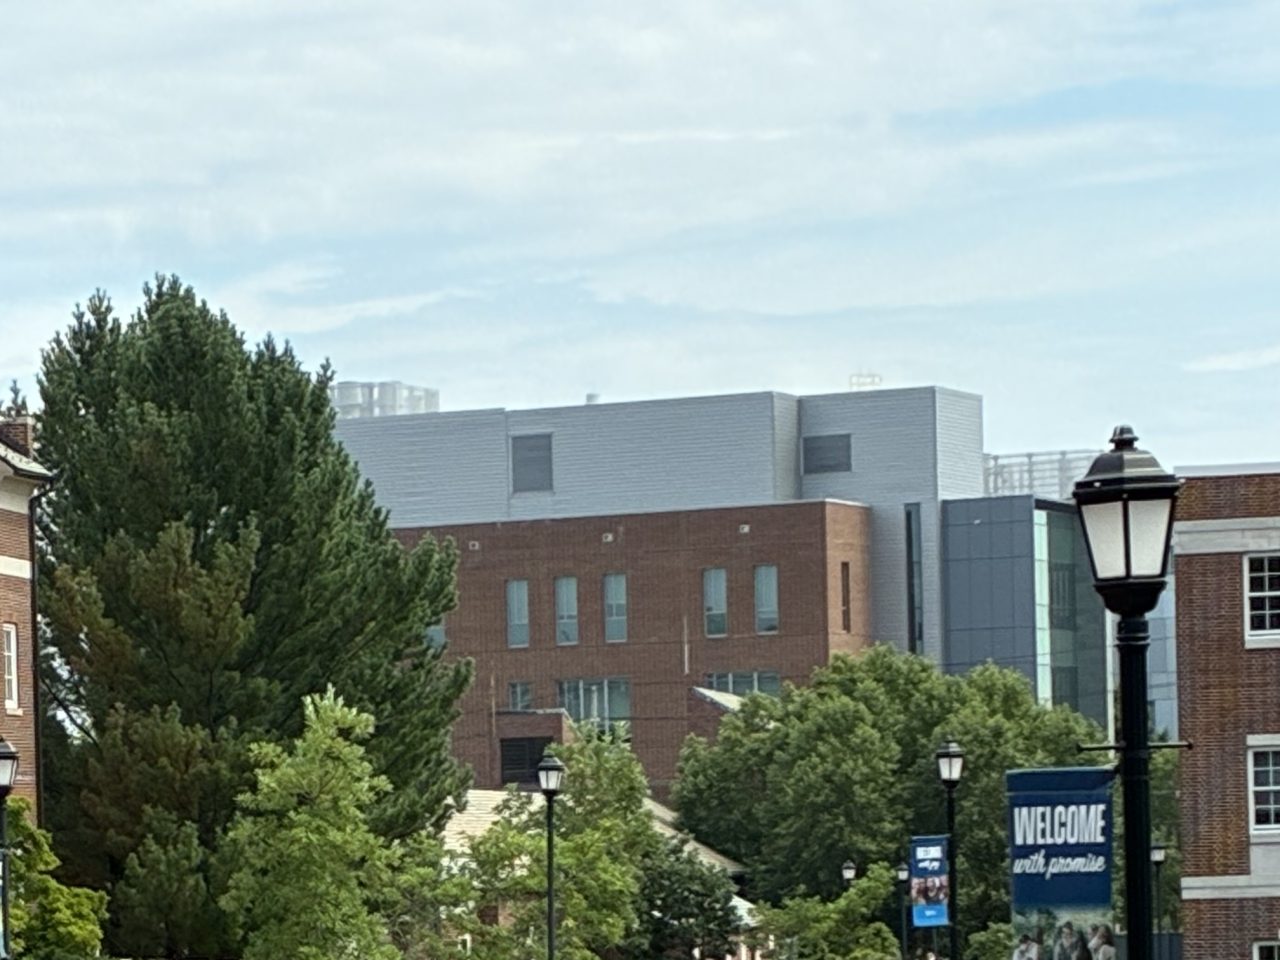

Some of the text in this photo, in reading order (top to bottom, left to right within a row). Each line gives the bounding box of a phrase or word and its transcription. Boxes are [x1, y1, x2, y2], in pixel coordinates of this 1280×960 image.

[1014, 804, 1106, 845] WELCOME
[1013, 849, 1106, 880] with promise
